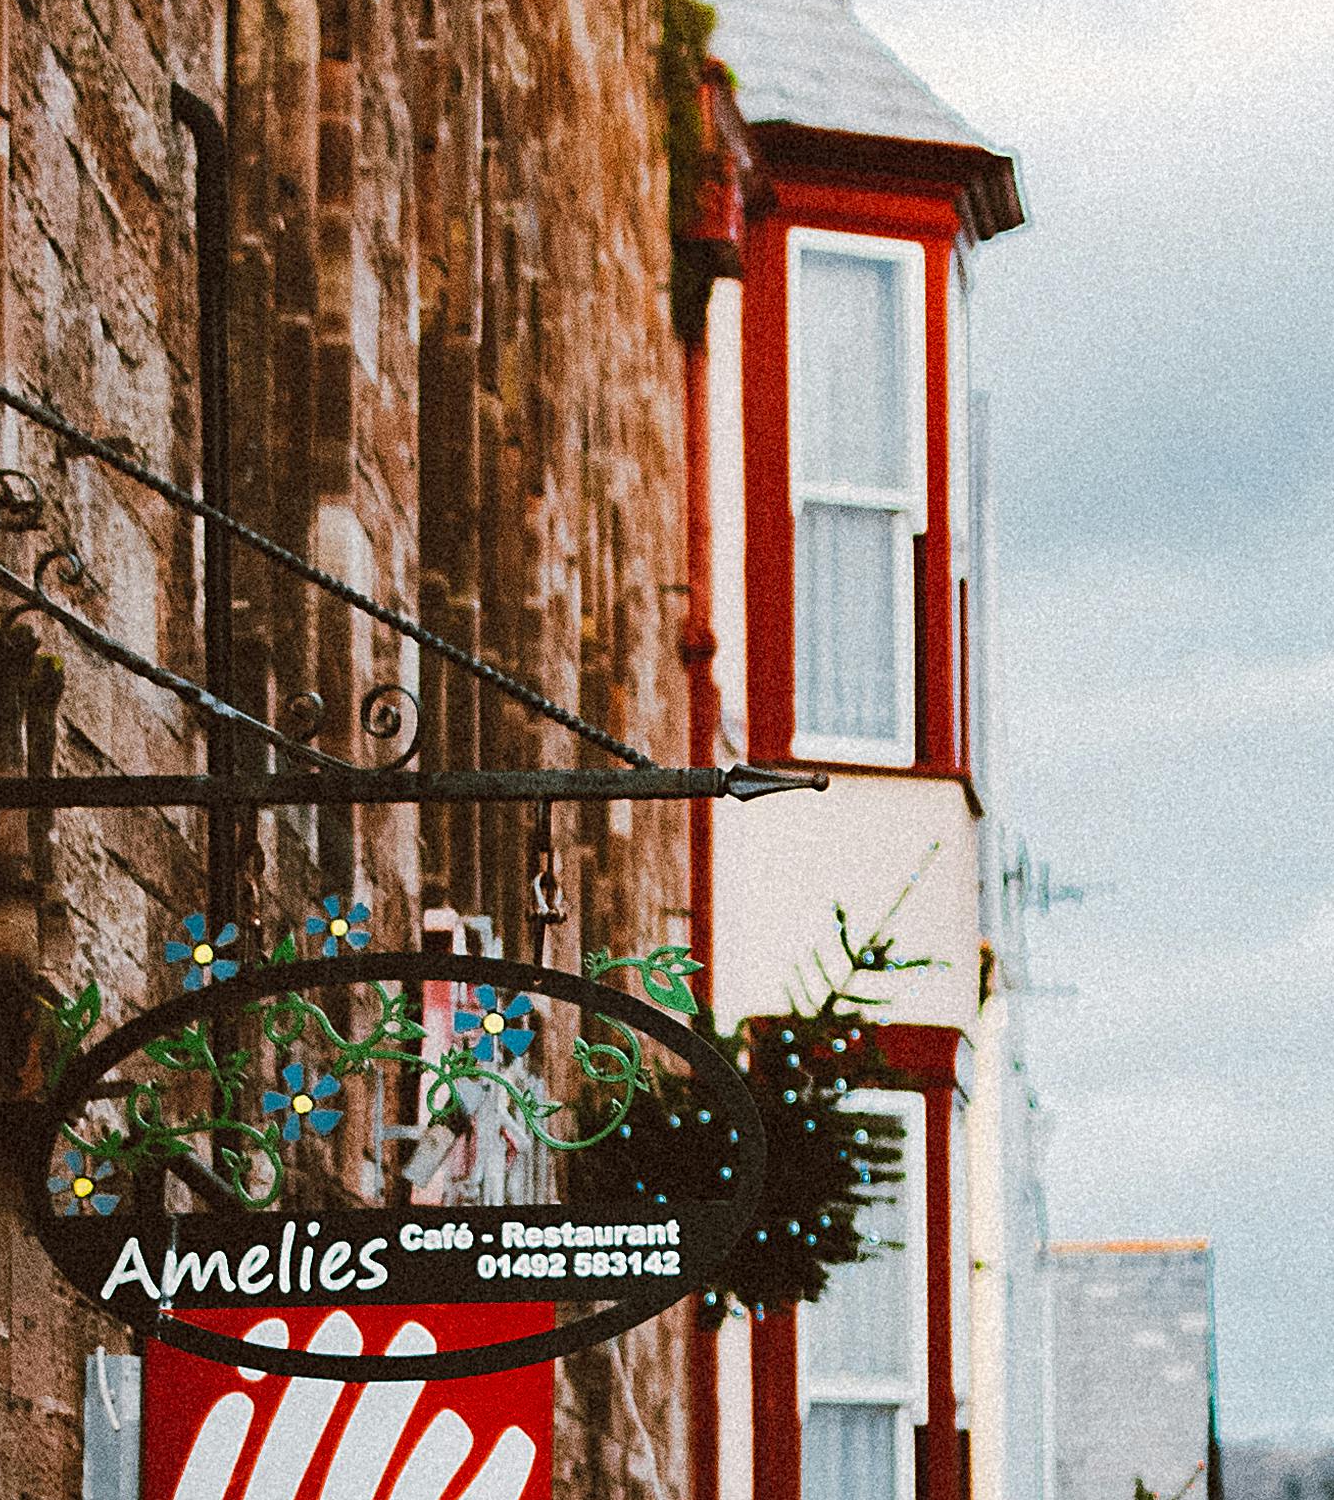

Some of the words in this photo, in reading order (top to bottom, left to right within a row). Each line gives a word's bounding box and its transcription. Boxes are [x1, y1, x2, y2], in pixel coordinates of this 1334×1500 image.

[399, 1222, 474, 1251] Café
[501, 1219, 680, 1249] Restaurant
[100, 1221, 389, 1299] Amelies
[477, 1252, 567, 1279] 01492
[573, 1250, 681, 1278] 583142
